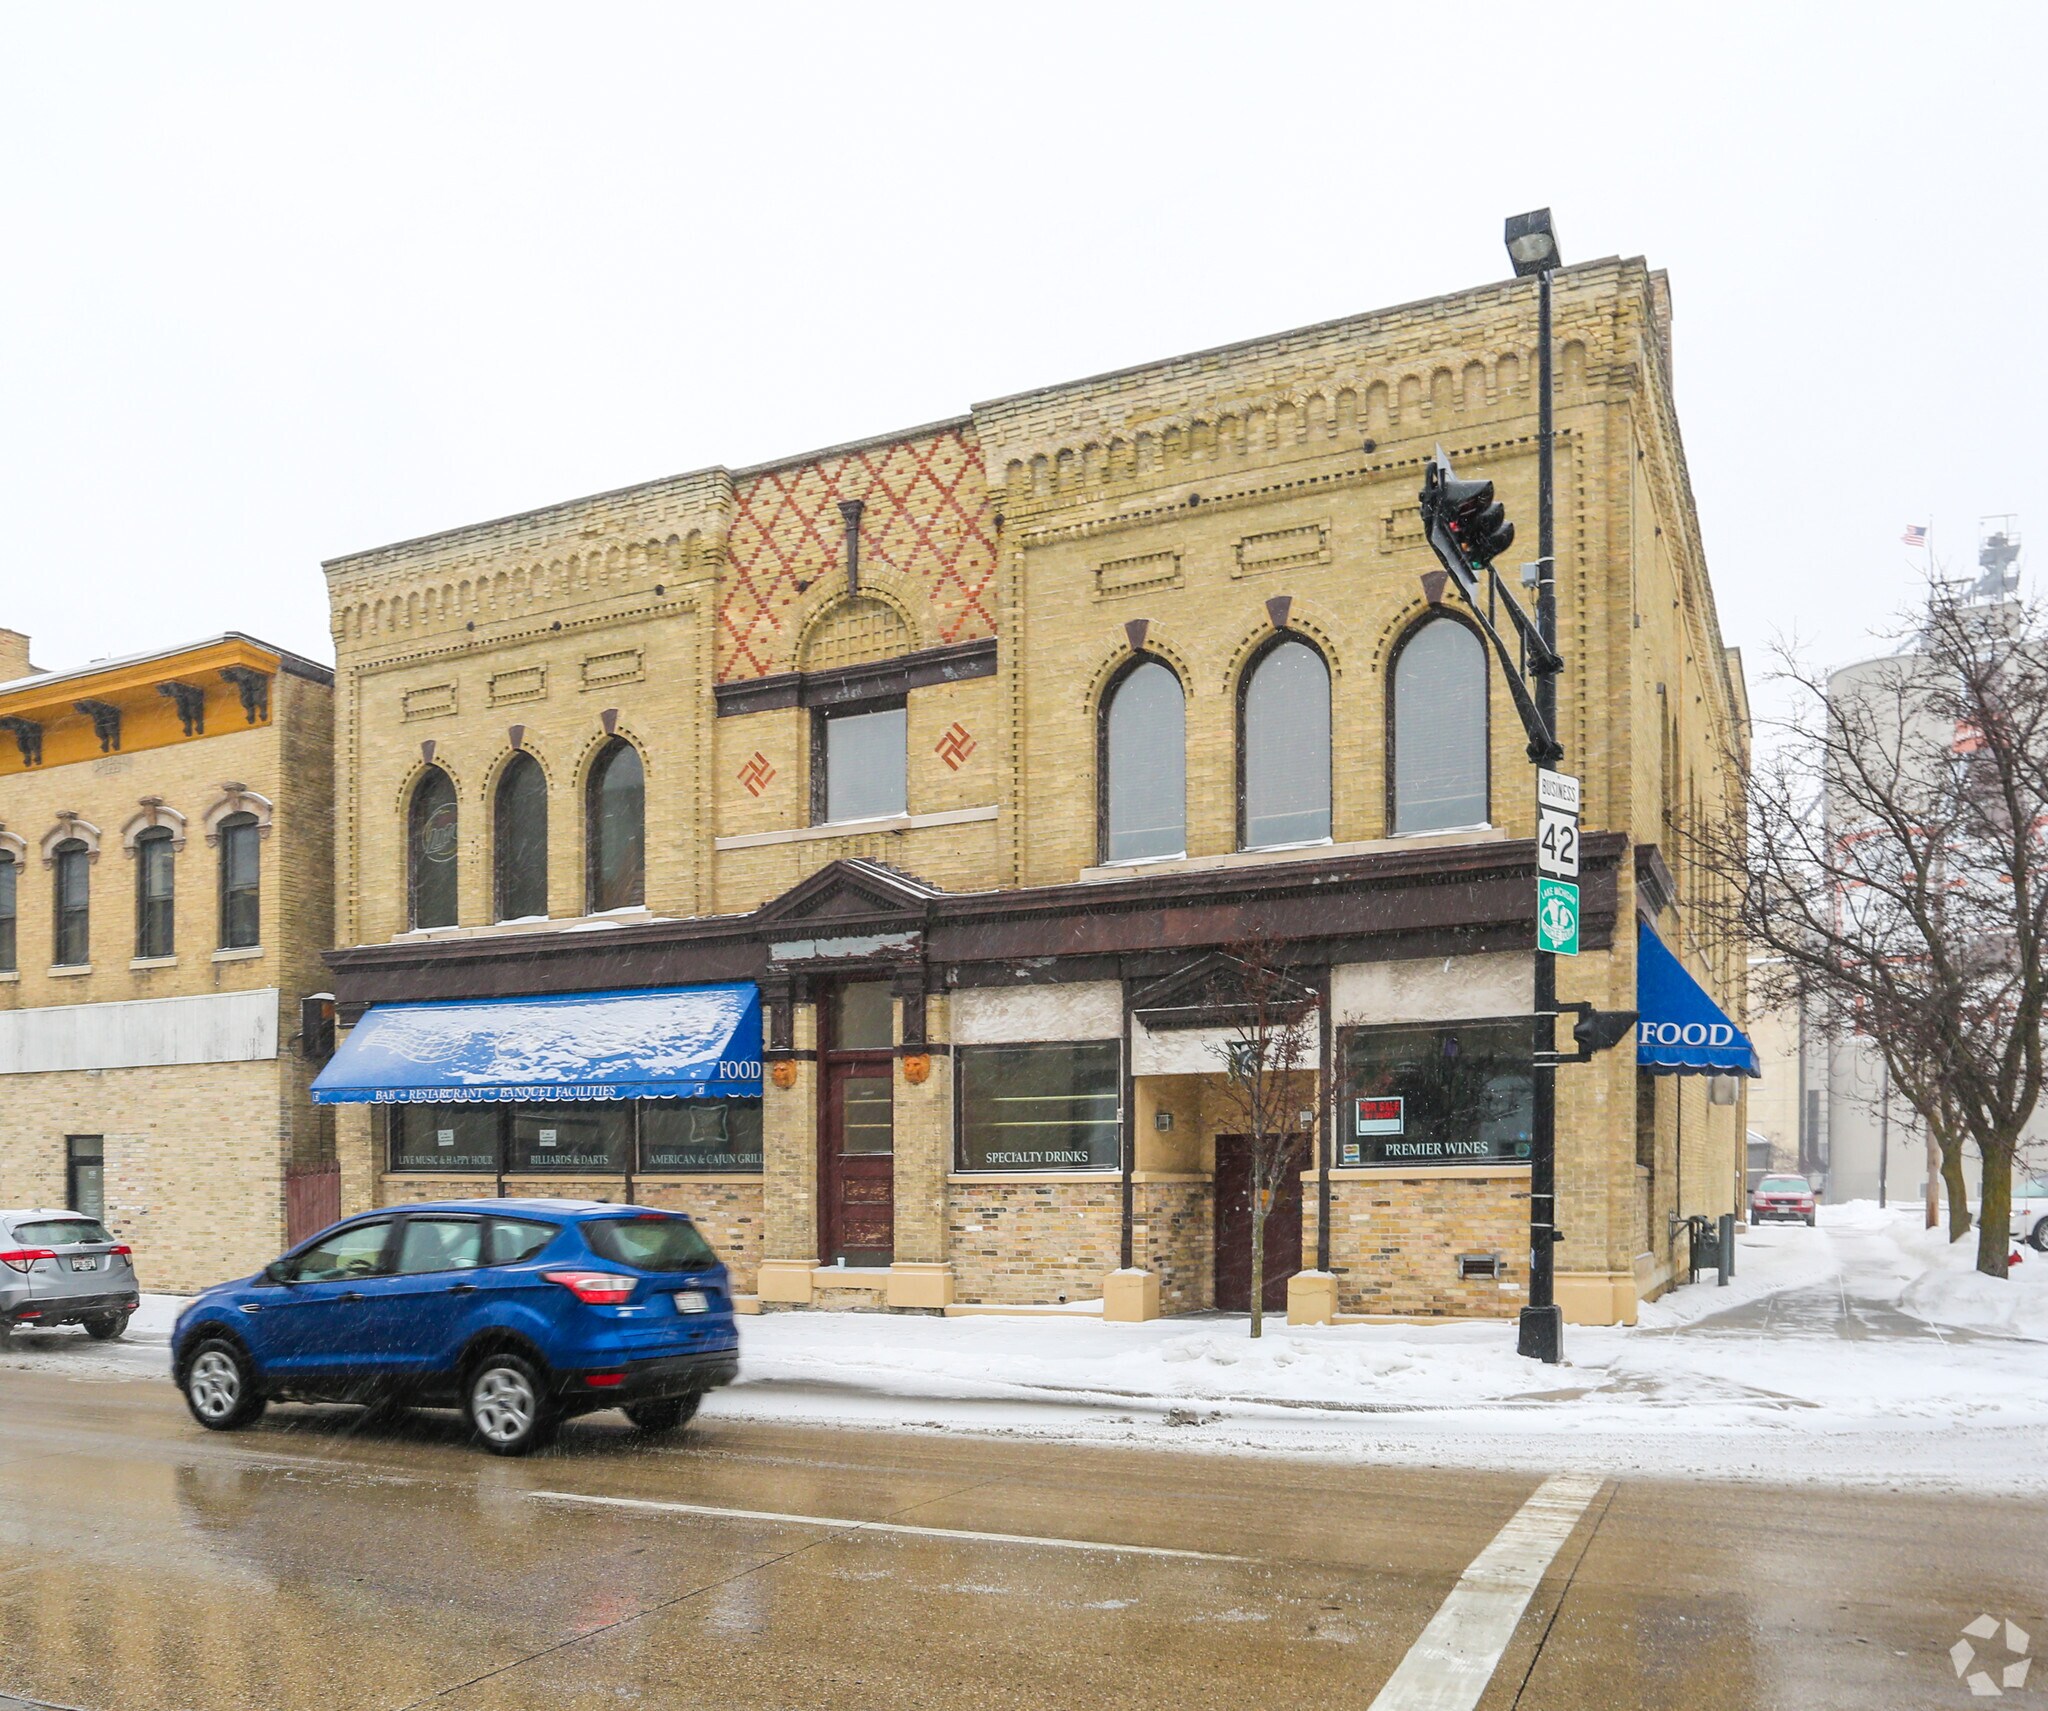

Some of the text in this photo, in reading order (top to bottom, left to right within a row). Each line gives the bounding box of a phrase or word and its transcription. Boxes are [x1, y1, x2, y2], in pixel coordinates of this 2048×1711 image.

[1541, 778, 1576, 802] BUSINESS
[1541, 822, 1574, 865] 42
[1541, 886, 1554, 900] LAKE
[1639, 1022, 1734, 1046] FOOD
[719, 1060, 762, 1079] FOOD
[375, 1089, 396, 1101] BAR
[500, 1086, 554, 1099] BANQUET
[556, 1085, 616, 1098] FACILITIES
[1360, 1101, 1400, 1112] FOR SALE
[1385, 1141, 1489, 1156] PREMIER WINES
[398, 1155, 493, 1165] LIVE MUSIC & HAPPY HOUR
[530, 1154, 609, 1164] BILLIARDS & DARTS
[649, 1153, 763, 1166] AMERICAN & CAJUN GRILL
[985, 1150, 1088, 1163] SPECIALTY DRINKS
